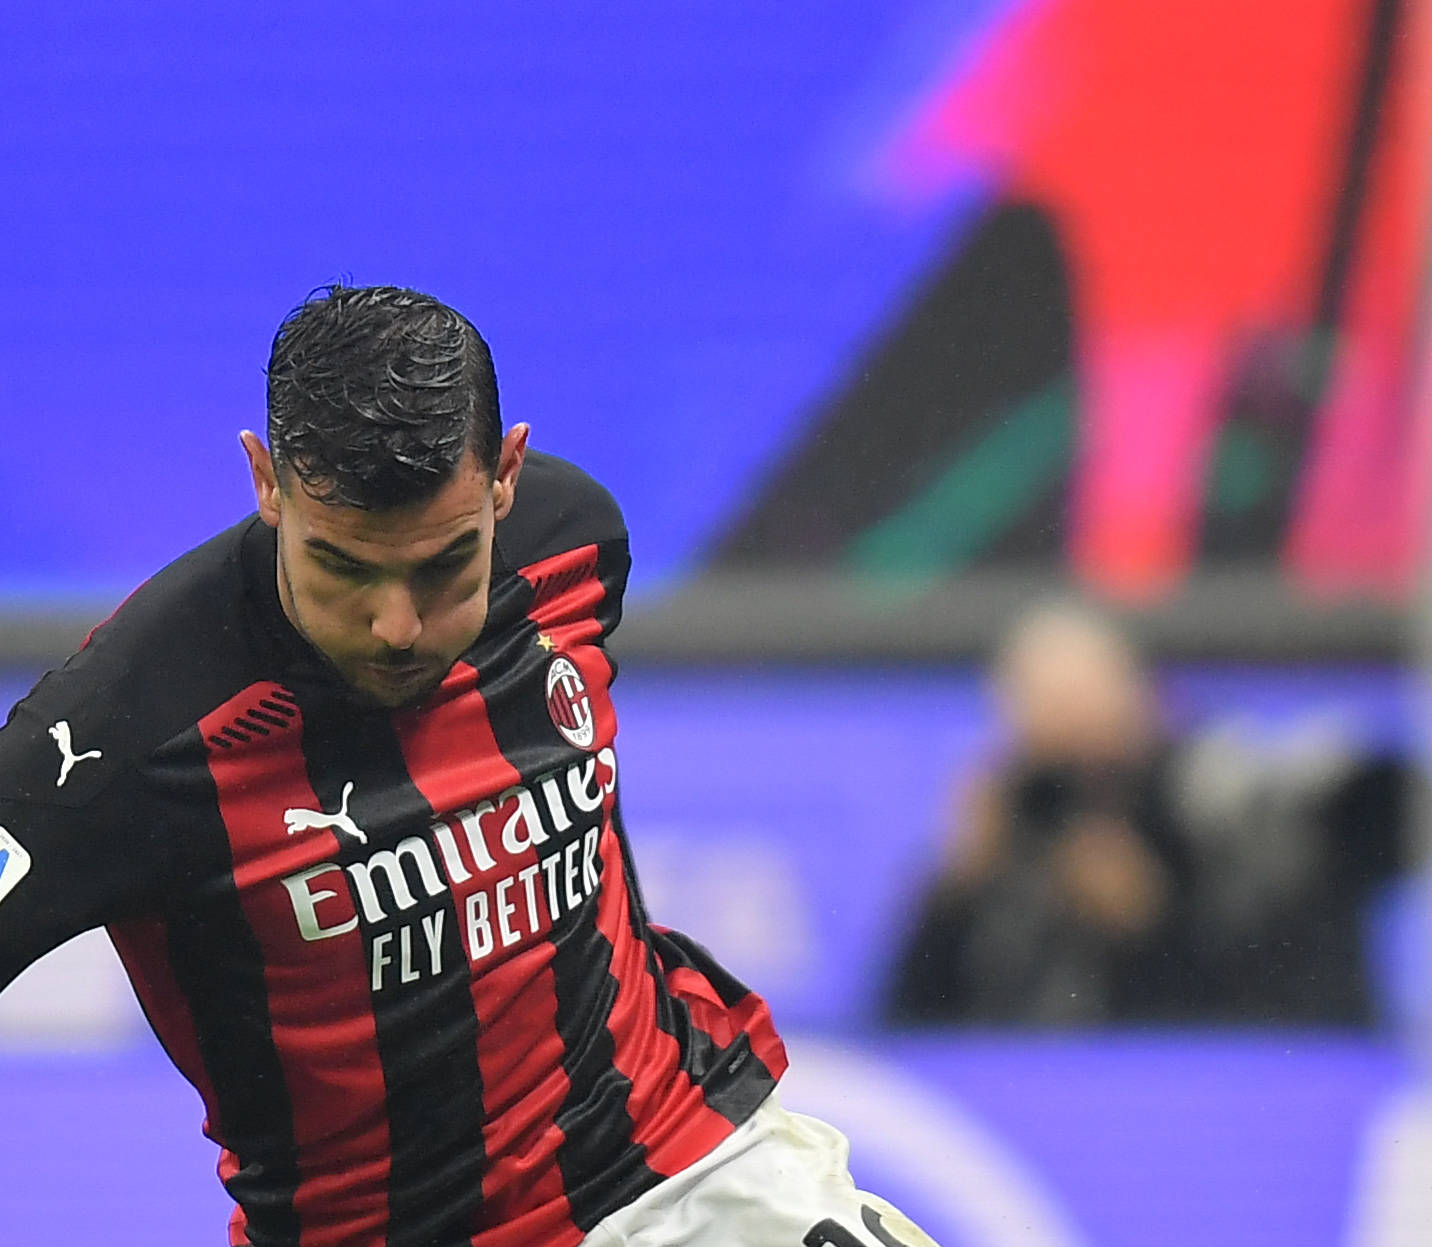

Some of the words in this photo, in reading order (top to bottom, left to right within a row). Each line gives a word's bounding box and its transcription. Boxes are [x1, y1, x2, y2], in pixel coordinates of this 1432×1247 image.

[549, 660, 573, 681] ACM
[280, 746, 618, 943] Emirates
[371, 908, 446, 992] FLY
[463, 827, 601, 962] BETTER
